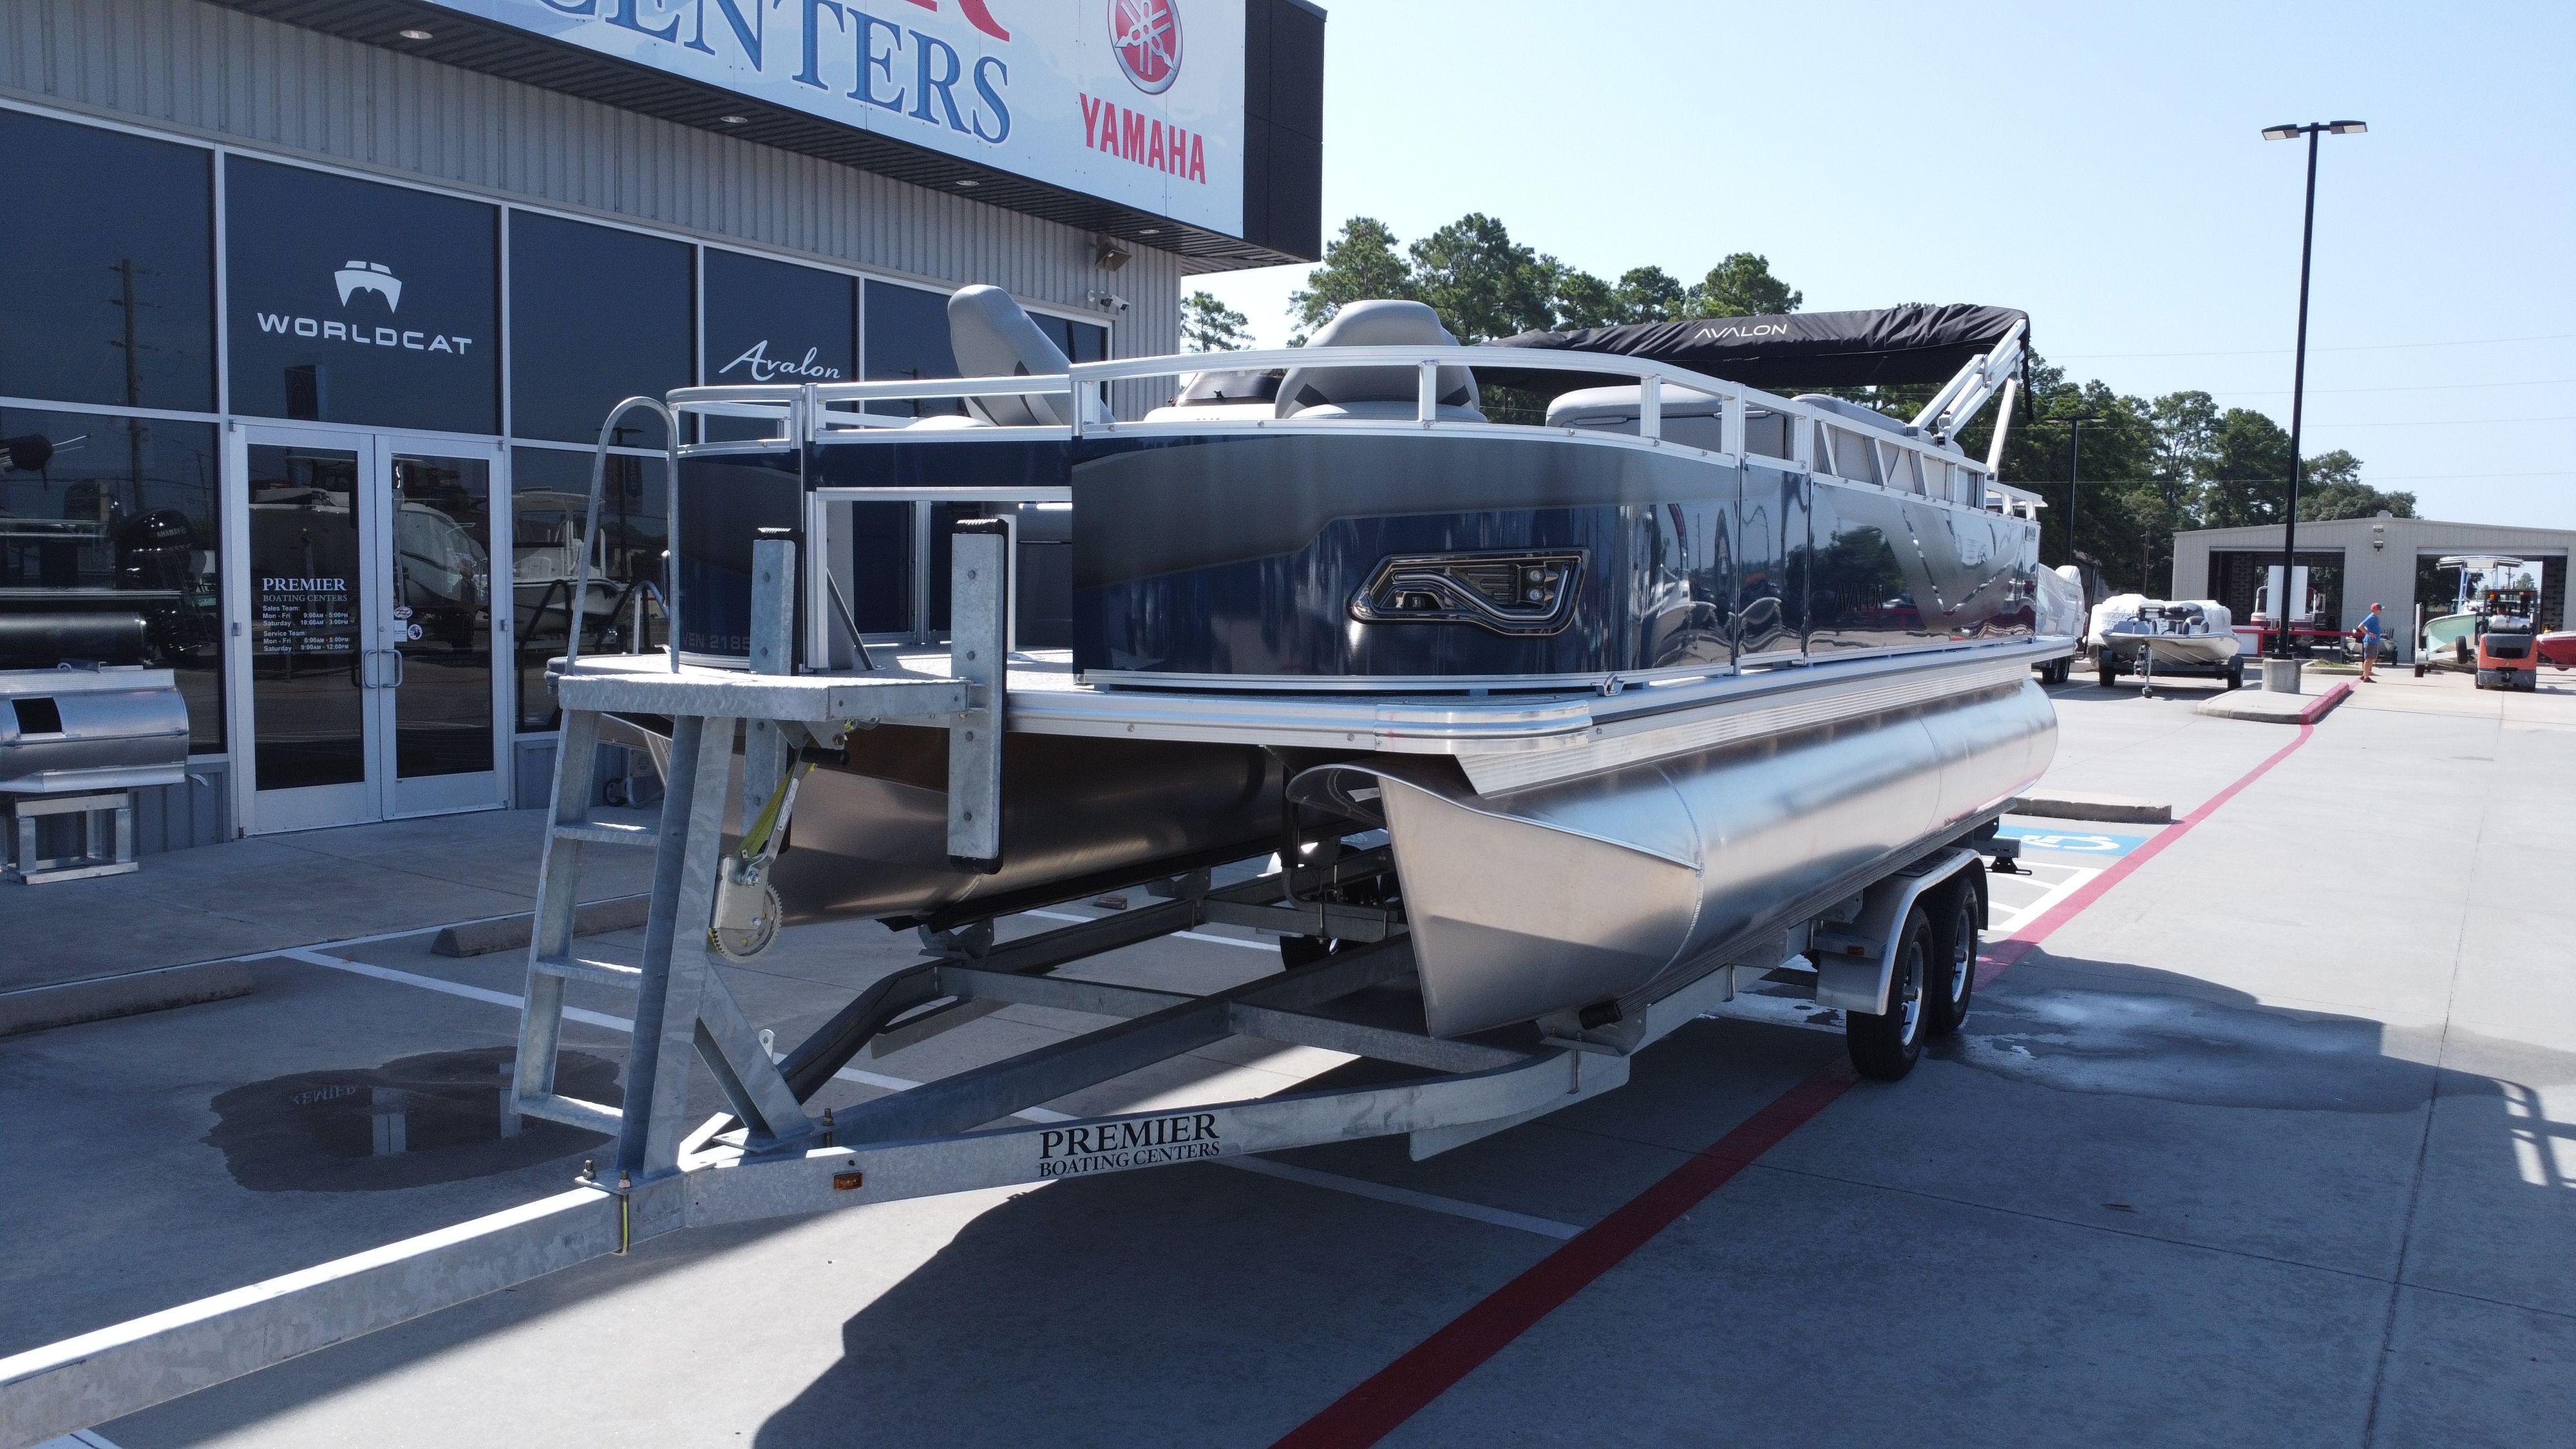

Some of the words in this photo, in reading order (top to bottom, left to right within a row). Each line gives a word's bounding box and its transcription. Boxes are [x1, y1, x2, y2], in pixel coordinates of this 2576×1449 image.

[540, 0, 1010, 144] NTERS
[1079, 91, 1206, 185] YAMAHA
[257, 312, 472, 355] WORLDCAT
[1694, 323, 1788, 339] AVALON
[719, 339, 840, 381] Avalon
[262, 578, 347, 591] PREMIER
[1039, 1112, 1220, 1160] PREMIER
[1038, 1151, 1130, 1178] BOATING
[1133, 1141, 1220, 1166] CENTERS
